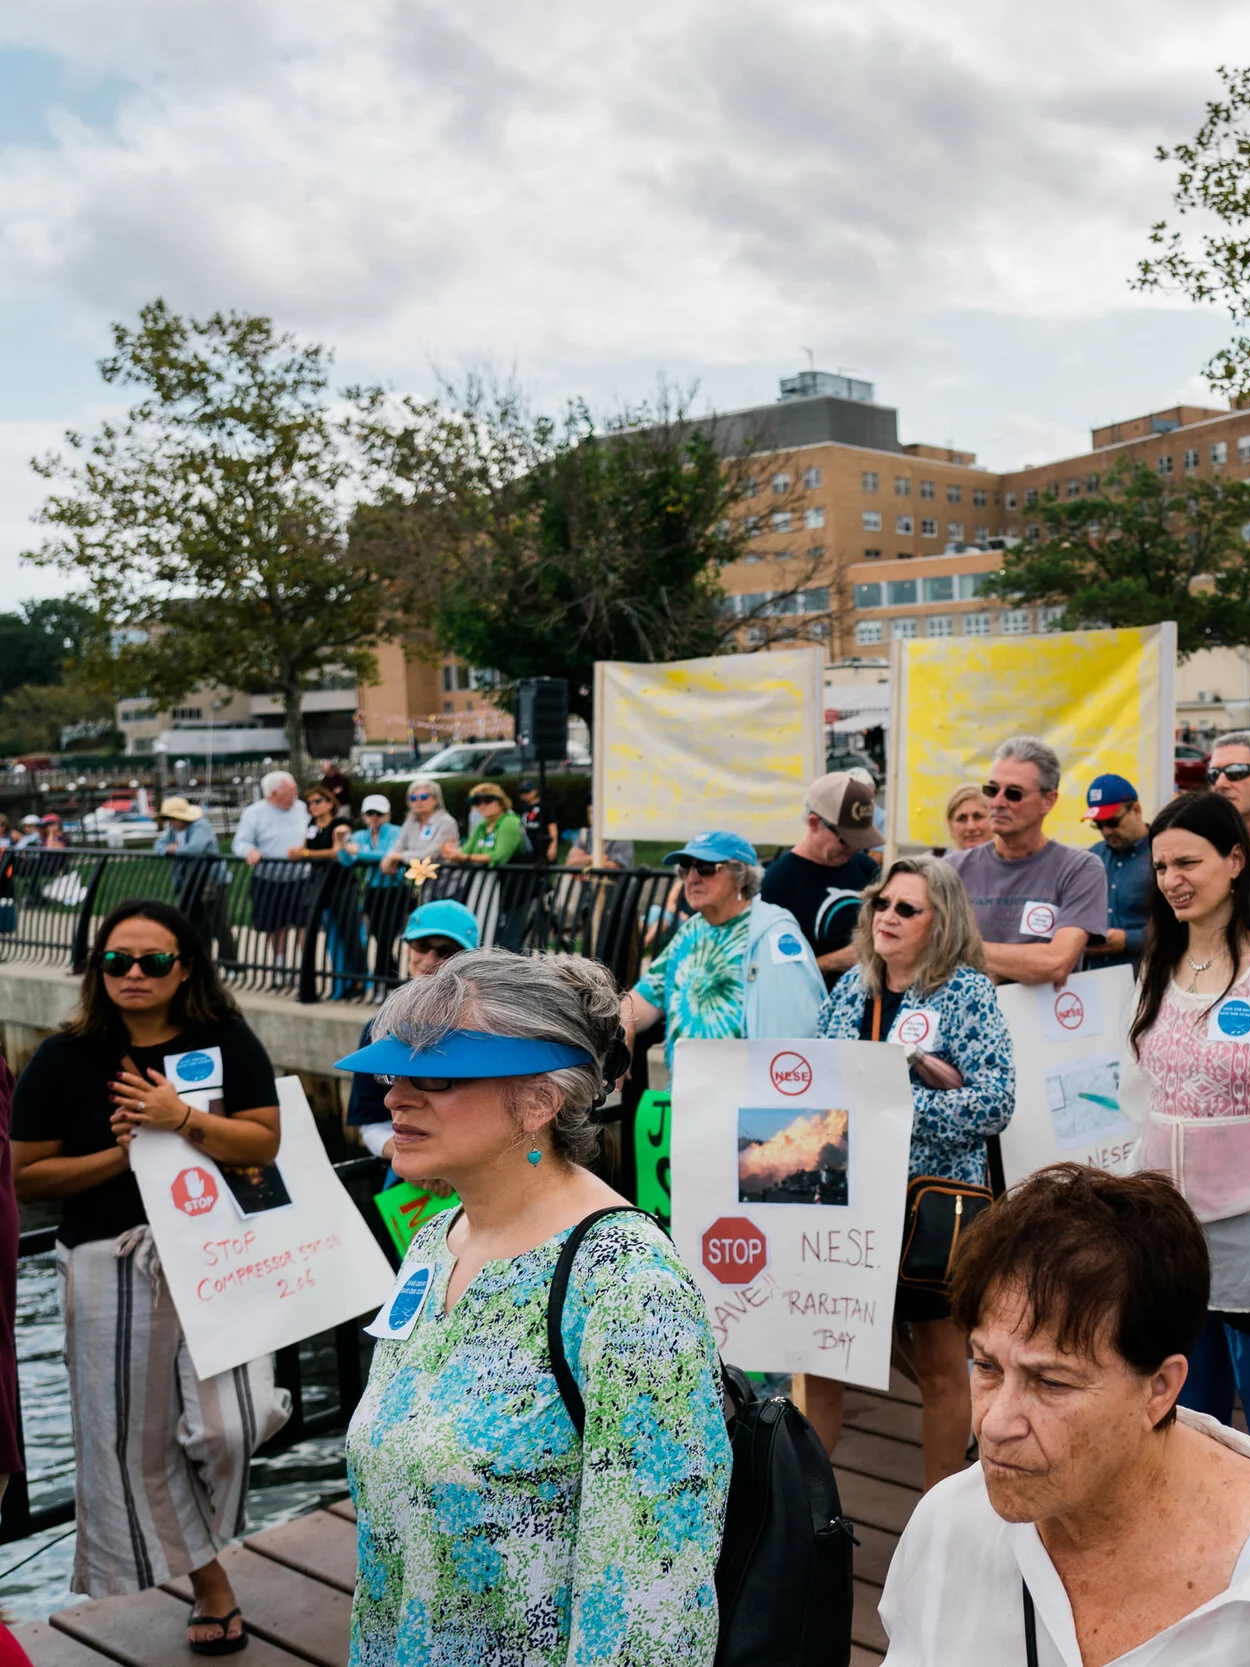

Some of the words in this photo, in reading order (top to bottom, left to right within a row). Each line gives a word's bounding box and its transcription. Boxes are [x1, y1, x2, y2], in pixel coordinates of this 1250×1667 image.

[775, 1071, 810, 1082] NESE
[1087, 1141, 1137, 1169] NESE
[183, 1195, 215, 1213] STOP
[203, 1230, 256, 1267] STOP
[708, 1238, 763, 1264] STOP
[197, 1250, 297, 1302] COMPRESSOR
[783, 1290, 877, 1326] RARITAN
[813, 1328, 857, 1371] BAY
